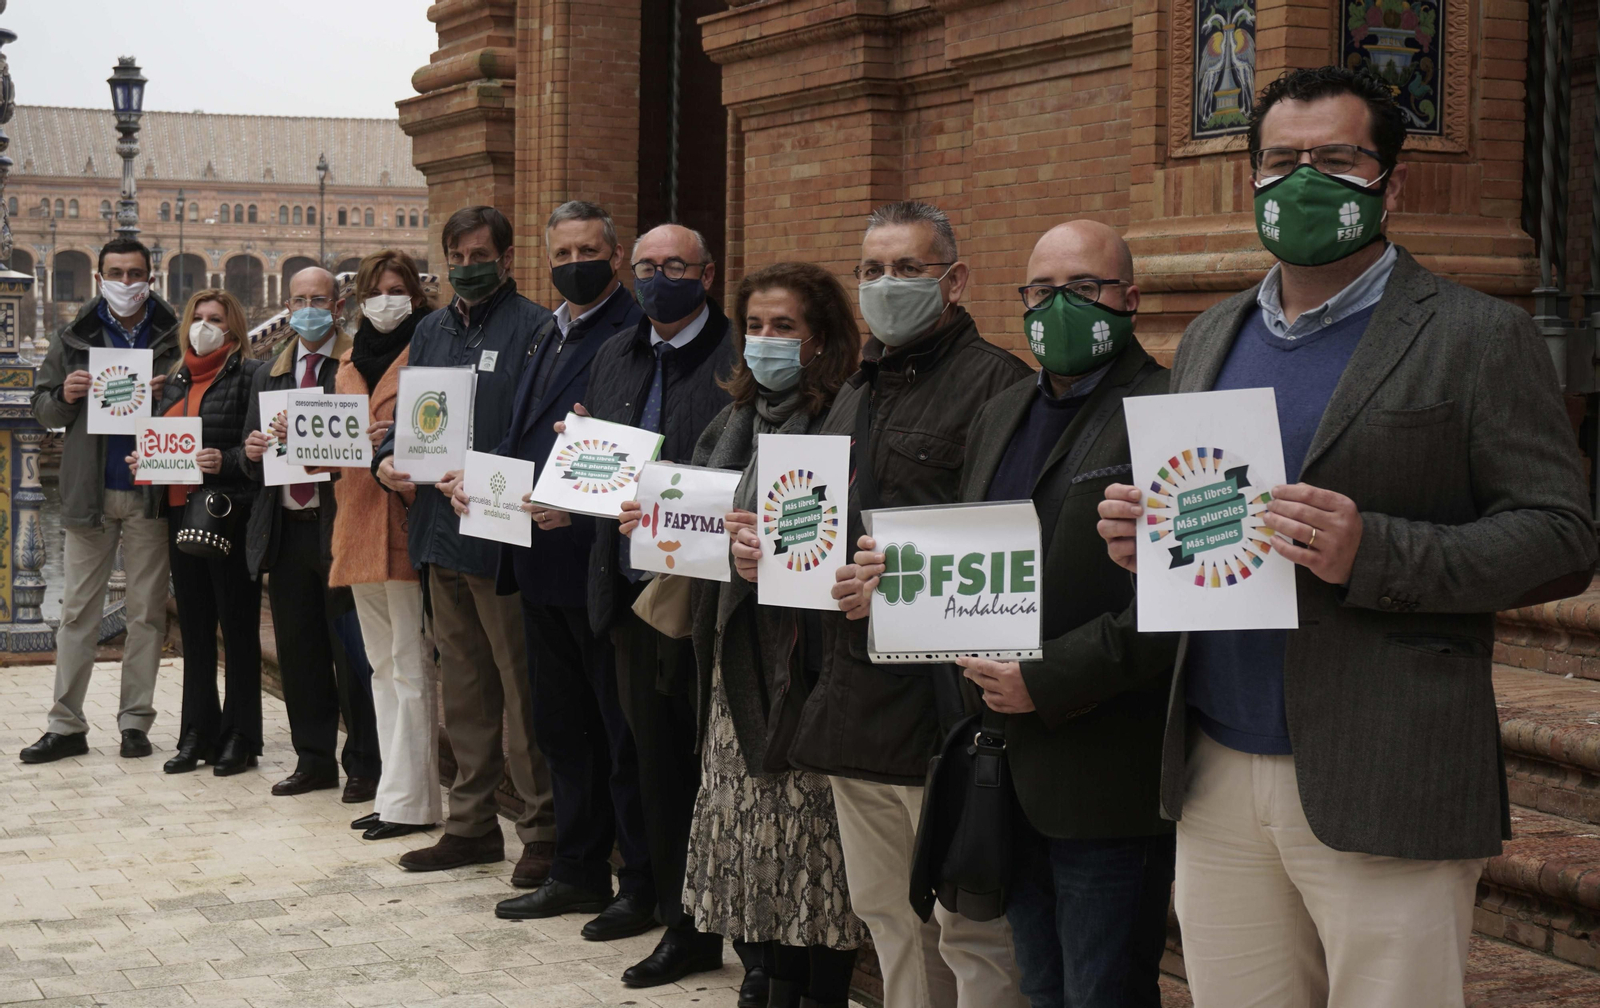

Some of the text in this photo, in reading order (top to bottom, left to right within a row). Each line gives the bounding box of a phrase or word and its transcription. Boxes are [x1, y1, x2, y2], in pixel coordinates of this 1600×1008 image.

[1261, 224, 1280, 240] FSIE
[1337, 226, 1364, 240] FSIE
[1031, 342, 1046, 354] FSIE
[1092, 342, 1113, 355] FSIE
[295, 400, 359, 409] asesoramiento y apoyo
[295, 414, 360, 439] cece
[413, 426, 446, 444] CONCAPA
[296, 443, 363, 461] andalucía
[408, 445, 448, 454] ANDALUCÍA
[469, 496, 492, 506] escuelas
[1182, 486, 1233, 506] Más libres
[785, 499, 816, 511] Más libres
[664, 511, 725, 534] FAPYMA
[779, 513, 821, 528] Más plurales
[1176, 505, 1245, 531] Más plurales
[783, 530, 815, 543] Más iguales
[1186, 529, 1239, 550] Más iguales
[930, 550, 1036, 597] FSIE
[944, 593, 1038, 619] Andalucía
